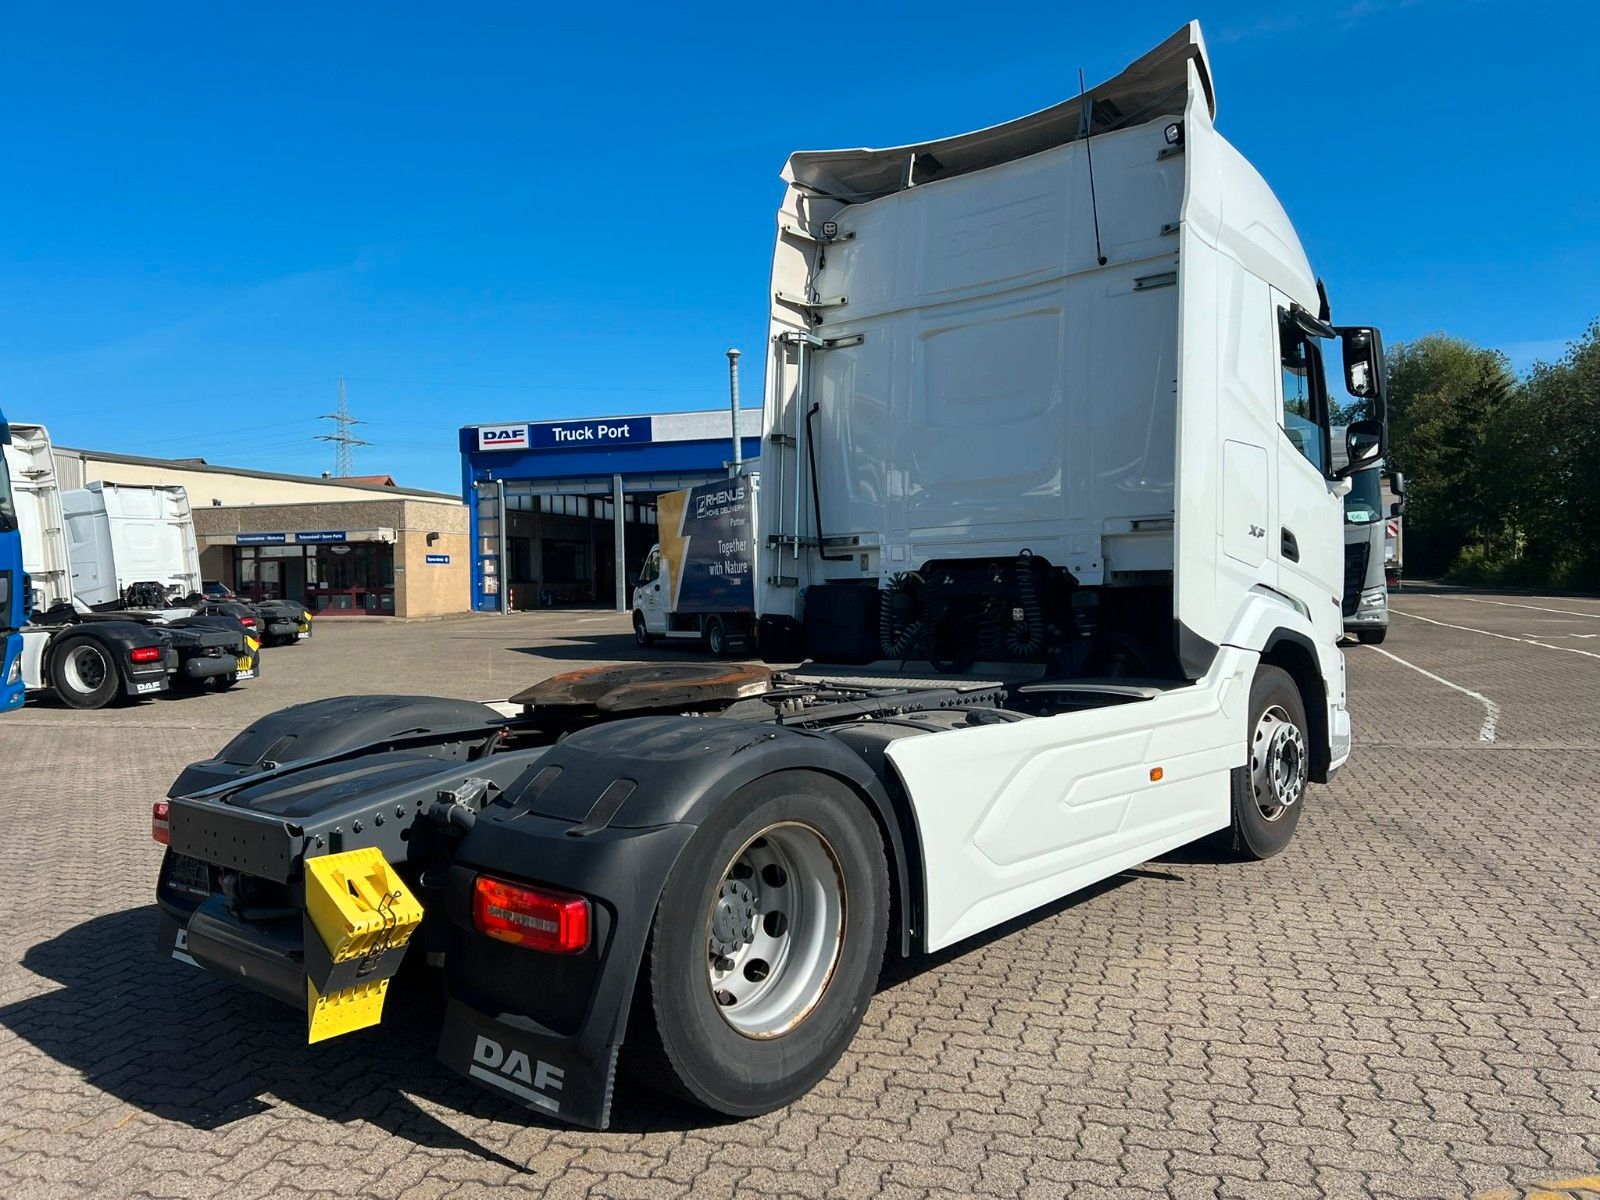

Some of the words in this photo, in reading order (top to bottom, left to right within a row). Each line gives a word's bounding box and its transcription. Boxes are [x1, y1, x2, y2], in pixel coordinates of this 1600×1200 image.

[483, 429, 525, 441] DAF
[552, 426, 594, 441] Truck
[597, 424, 630, 439] Port
[706, 487, 745, 506] RHENUS
[718, 538, 747, 556] Together
[709, 561, 723, 575] with
[724, 560, 748, 575] Nature
[136, 681, 161, 691] DAF
[472, 1034, 565, 1091] DAF
